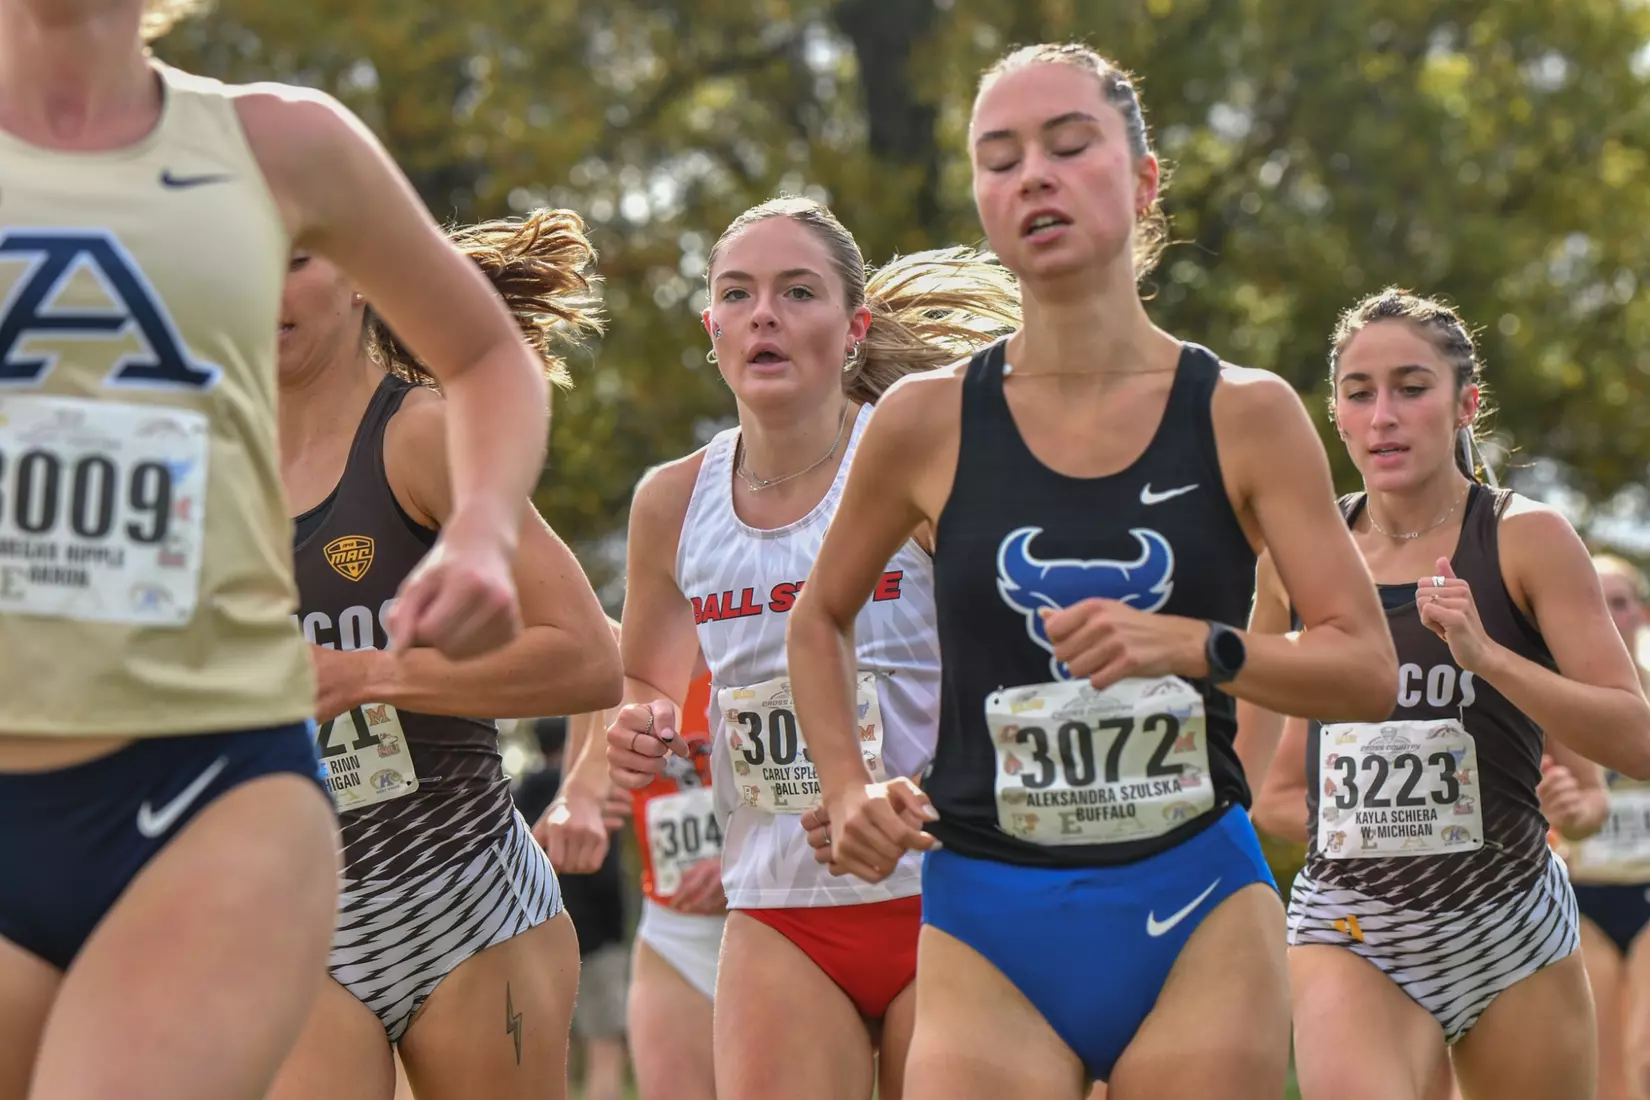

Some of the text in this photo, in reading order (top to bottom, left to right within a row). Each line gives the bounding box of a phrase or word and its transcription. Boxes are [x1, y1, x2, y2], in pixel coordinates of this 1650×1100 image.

[0, 227, 223, 391] A
[0, 449, 172, 543] 009
[330, 548, 372, 567] MAC
[1016, 712, 1183, 789] 3072
[330, 755, 360, 774] RINN
[763, 768, 790, 780] CARLY
[776, 783, 799, 795] BALL
[1334, 752, 1460, 810] 3223
[1027, 788, 1117, 808] ALEKSANDRA
[1120, 779, 1183, 801] SZULSKA
[1075, 803, 1136, 822] BUFFALO
[1355, 811, 1387, 825] KAYLA
[1391, 808, 1438, 823] SCHIERA
[1378, 823, 1433, 838] MICHIGAN
